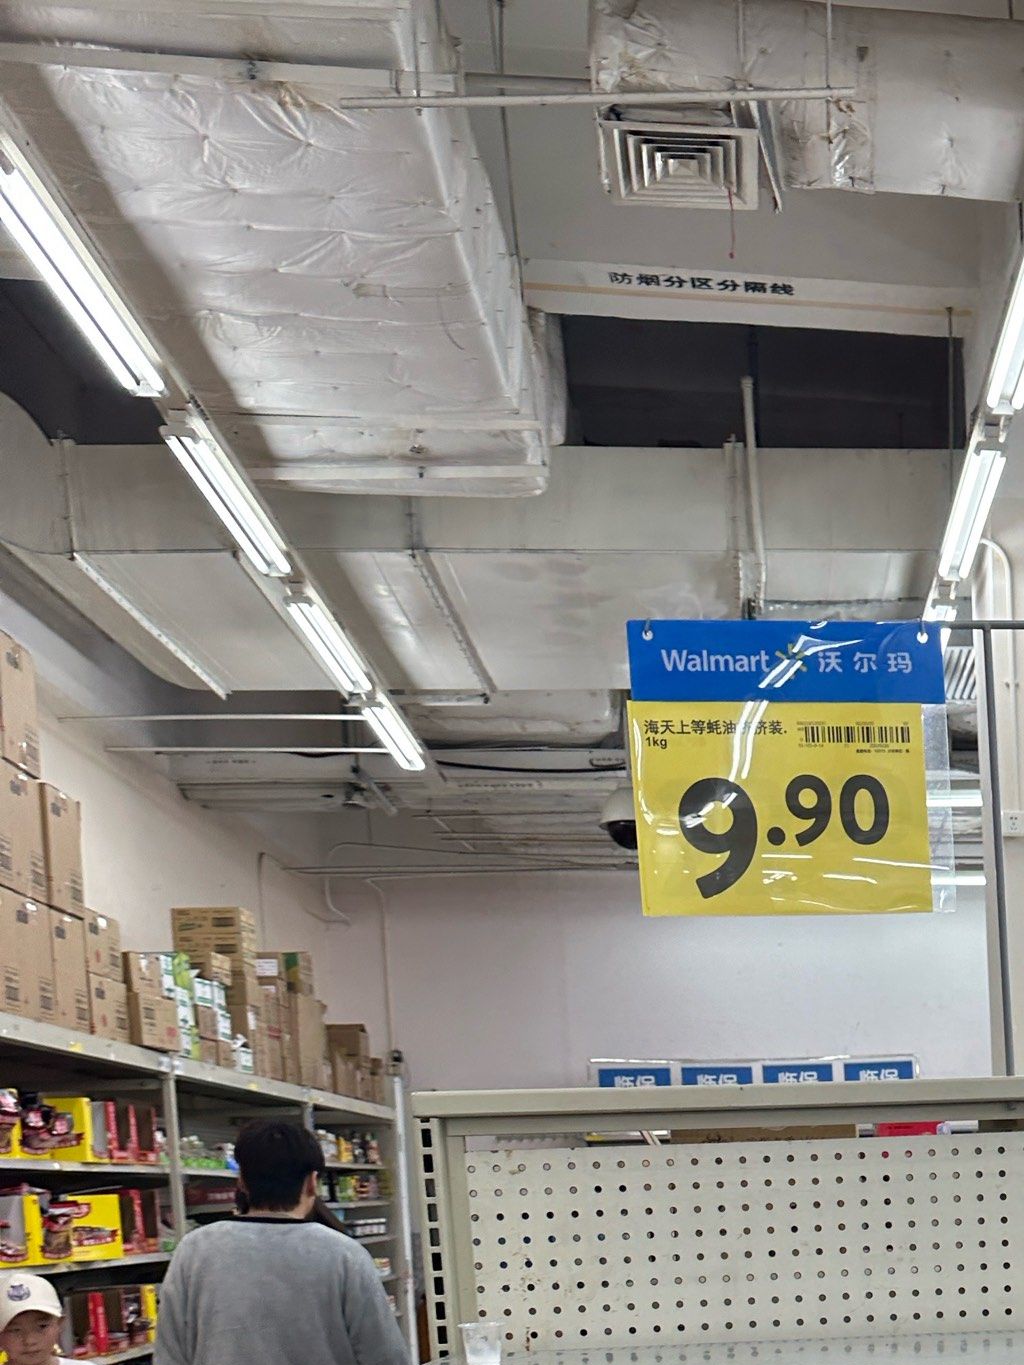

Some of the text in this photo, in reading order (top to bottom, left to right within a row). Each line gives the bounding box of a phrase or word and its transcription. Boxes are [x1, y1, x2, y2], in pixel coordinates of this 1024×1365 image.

[608, 271, 796, 296] 防烟分区分隔线
[661, 649, 913, 673] Walmart 沃尔玛
[645, 737, 668, 749] 1kg
[678, 774, 890, 900] 9.90
